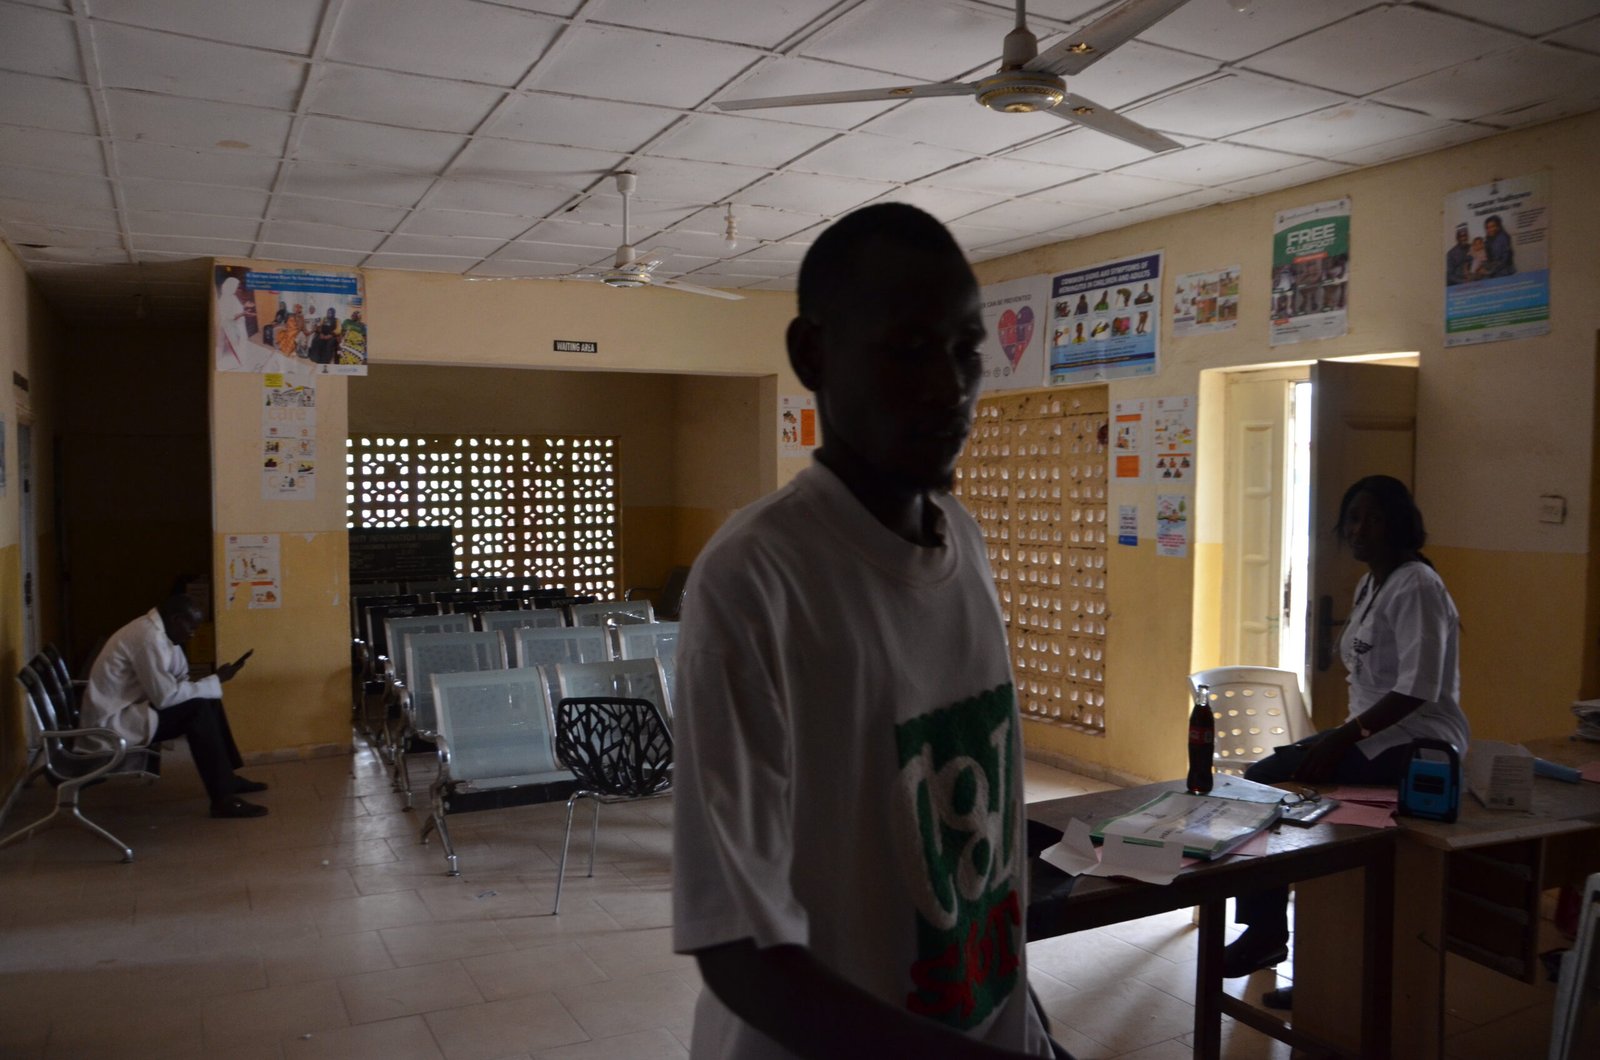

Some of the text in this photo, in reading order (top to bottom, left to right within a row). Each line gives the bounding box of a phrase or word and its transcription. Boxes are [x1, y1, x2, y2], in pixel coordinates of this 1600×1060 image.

[1286, 223, 1336, 246] FREE
[556, 341, 595, 353] WAITING AREA
